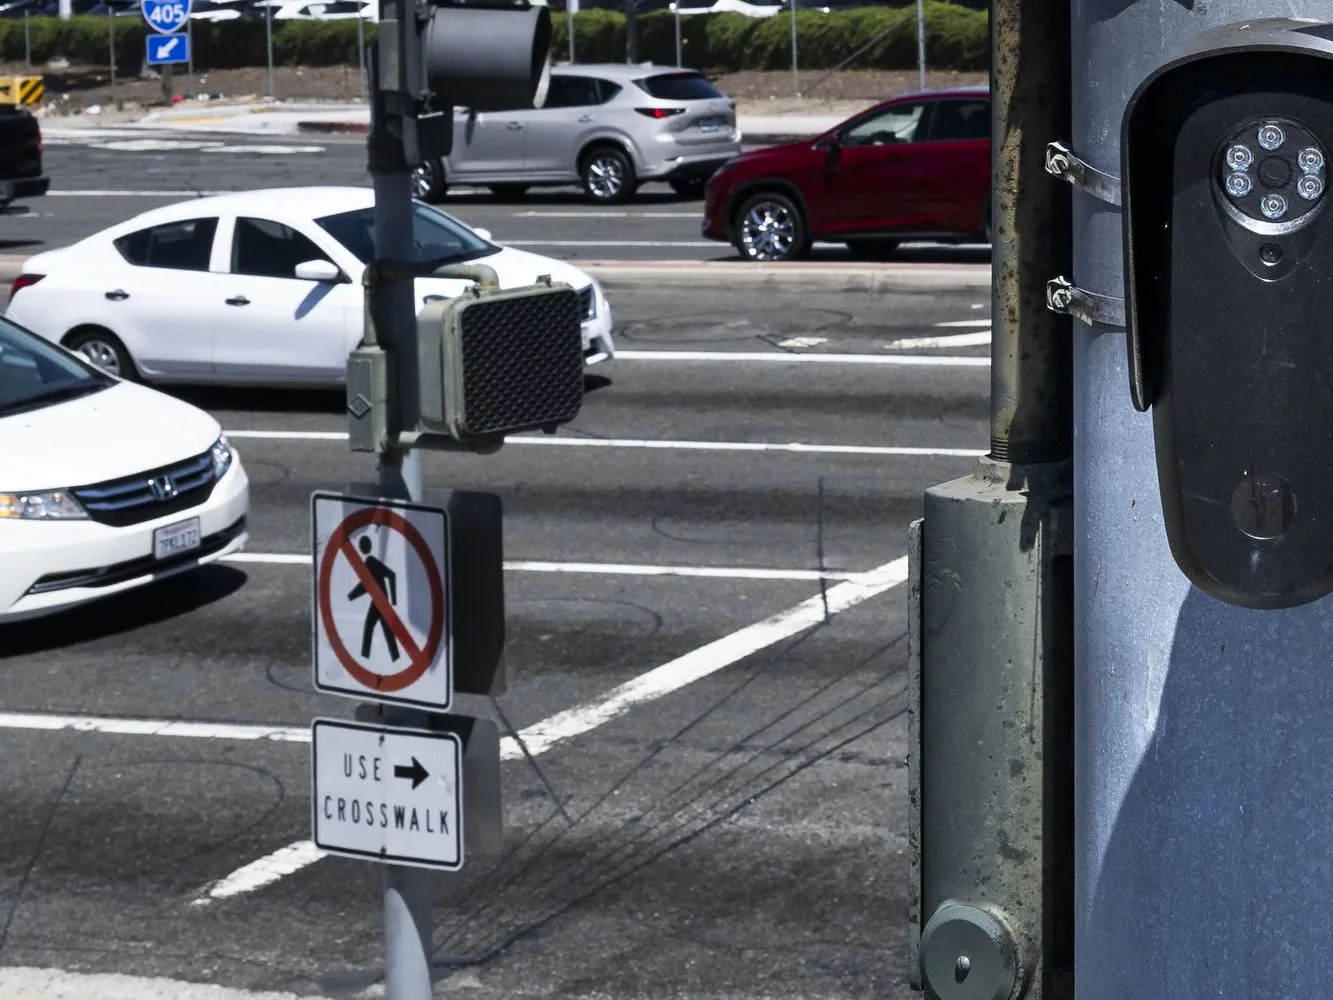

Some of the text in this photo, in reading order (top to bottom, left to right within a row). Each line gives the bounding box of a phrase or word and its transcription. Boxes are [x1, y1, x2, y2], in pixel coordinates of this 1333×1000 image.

[150, 3, 185, 23] 405
[344, 753, 381, 781] USE
[324, 795, 449, 835] CROSSWALK
